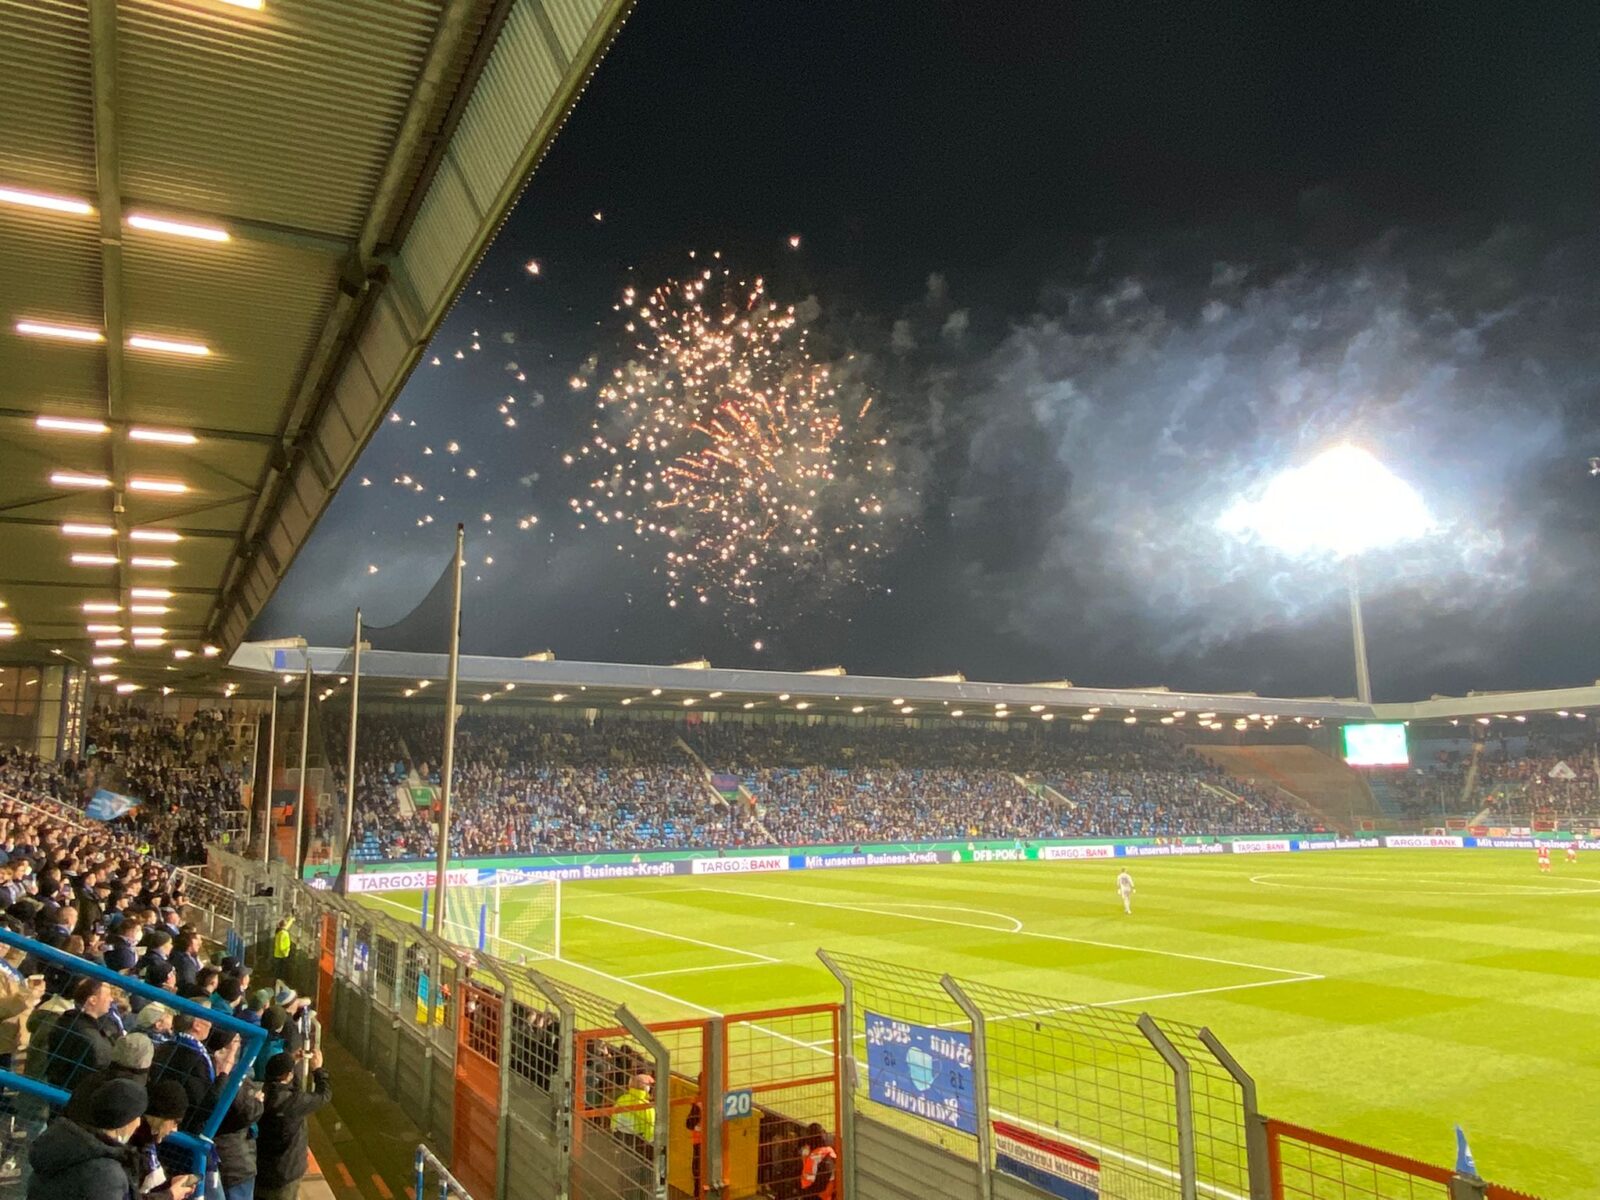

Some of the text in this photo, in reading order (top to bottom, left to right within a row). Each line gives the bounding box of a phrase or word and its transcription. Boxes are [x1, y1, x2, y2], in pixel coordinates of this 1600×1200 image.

[583, 862, 675, 879] Business-Kredit
[805, 855, 823, 869] Mit
[825, 855, 865, 867] unserem
[358, 873, 469, 890] TARGOBNK
[726, 1092, 750, 1117] 20
